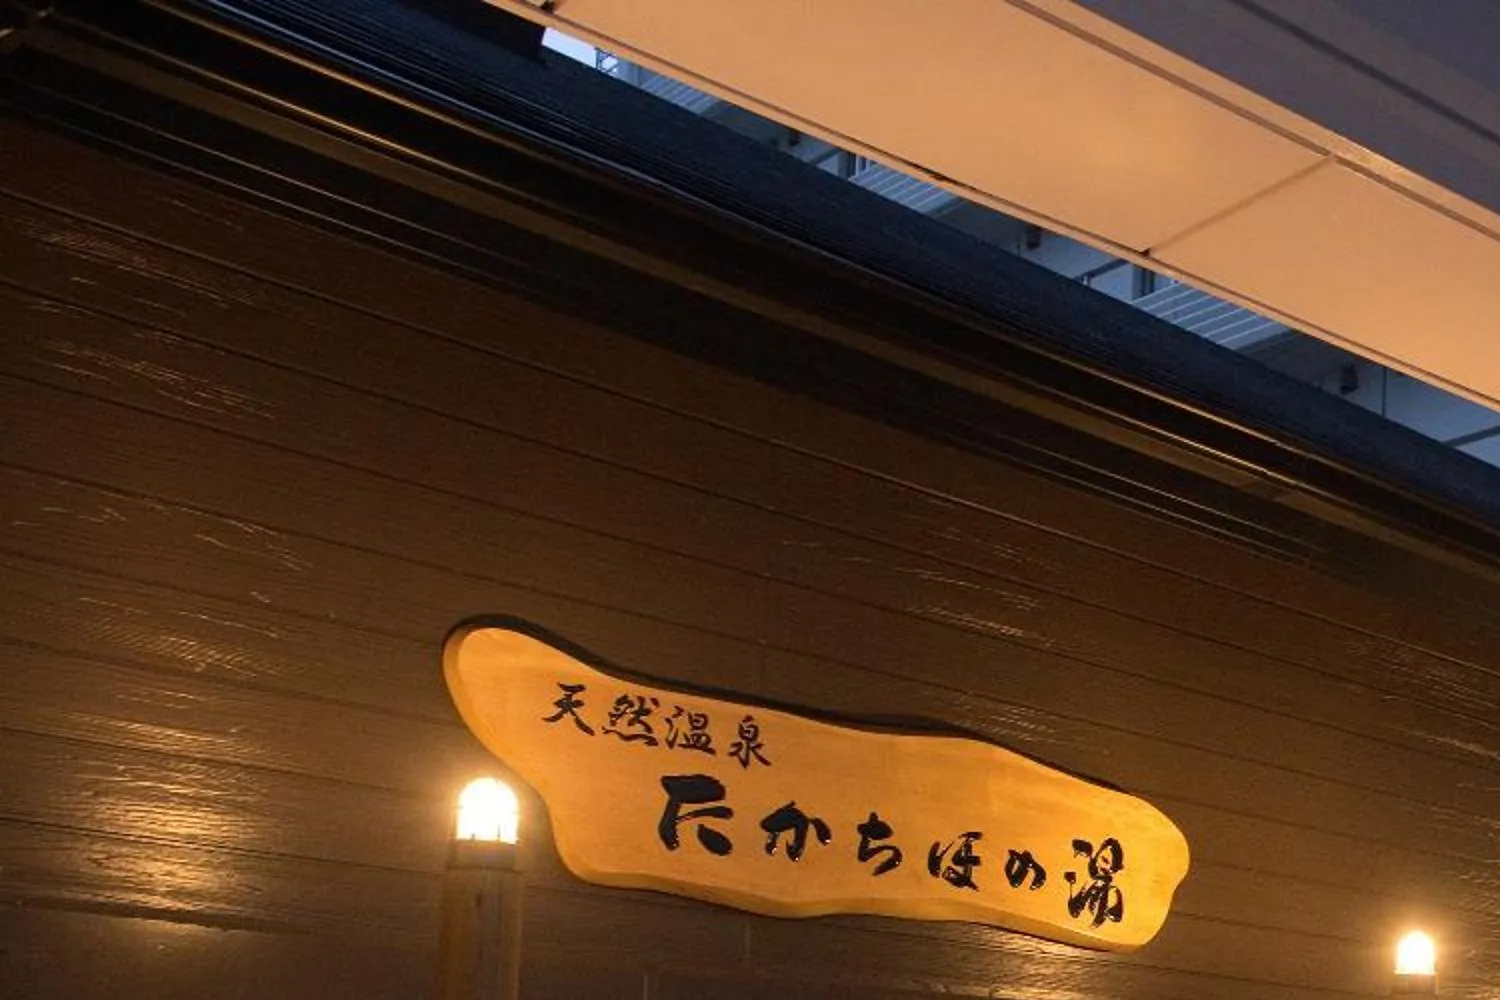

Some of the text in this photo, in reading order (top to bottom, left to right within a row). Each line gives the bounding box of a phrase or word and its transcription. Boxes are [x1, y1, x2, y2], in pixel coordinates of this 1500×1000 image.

[543, 682, 773, 769] 天然温泉
[657, 773, 1124, 928] たかちほの湯
